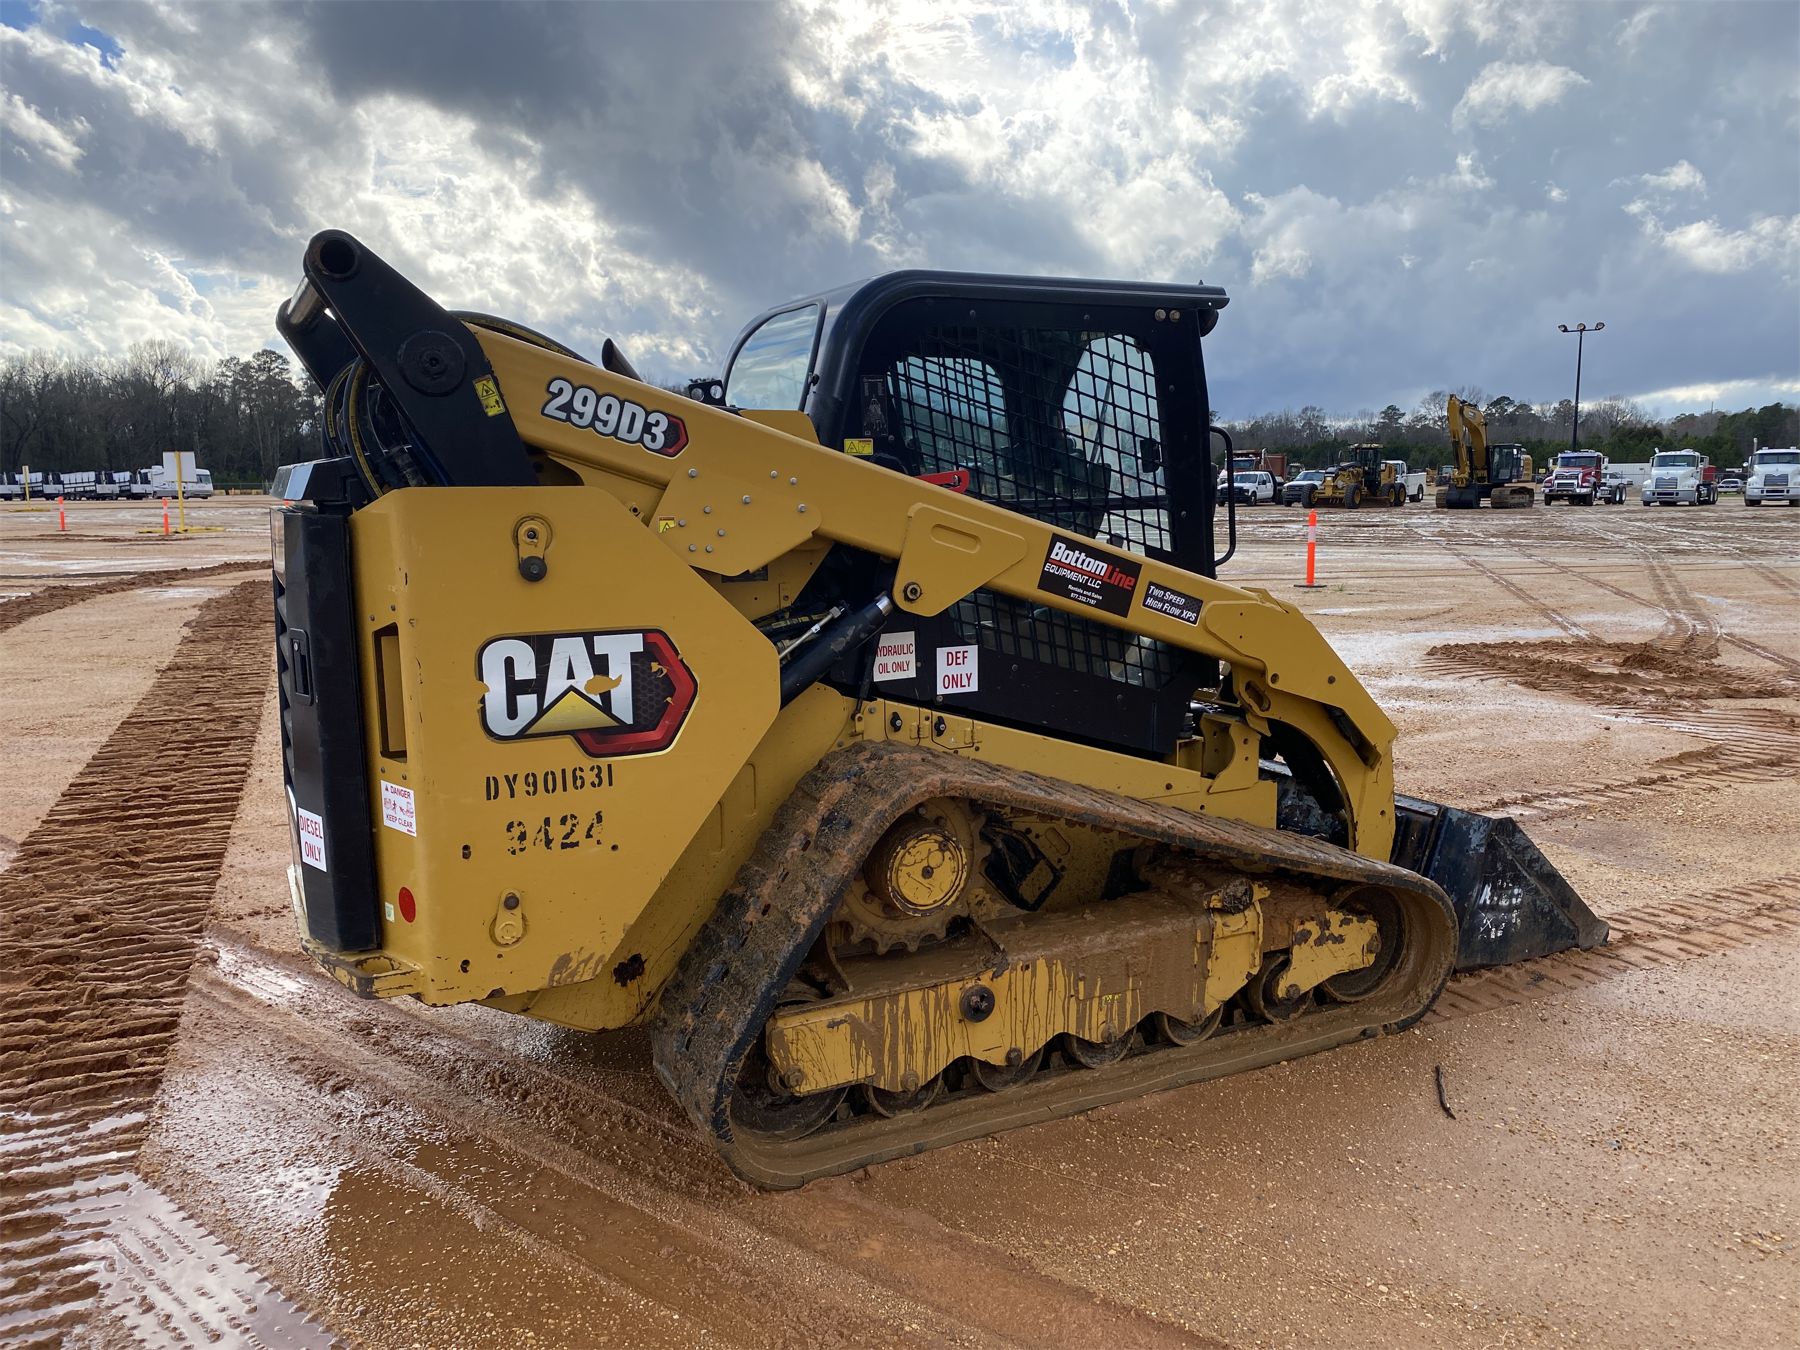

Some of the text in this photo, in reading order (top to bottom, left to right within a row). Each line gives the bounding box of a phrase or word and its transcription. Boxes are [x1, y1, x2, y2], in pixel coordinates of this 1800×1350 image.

[544, 379, 669, 450] 299D3
[1044, 562, 1102, 589] EQUIPMENT LLC
[1180, 609, 1197, 622] XPS
[878, 660, 910, 674] OIL ONLY
[946, 650, 968, 666] DEF
[481, 633, 644, 736] CAT
[942, 672, 972, 689] ONLY
[390, 785, 411, 800] DANGER
[485, 763, 614, 801] DY901631
[299, 815, 323, 839] DIESEL
[386, 814, 413, 829] KEEP CLEAR
[505, 809, 604, 856] 9424
[304, 841, 321, 862] ONLY
